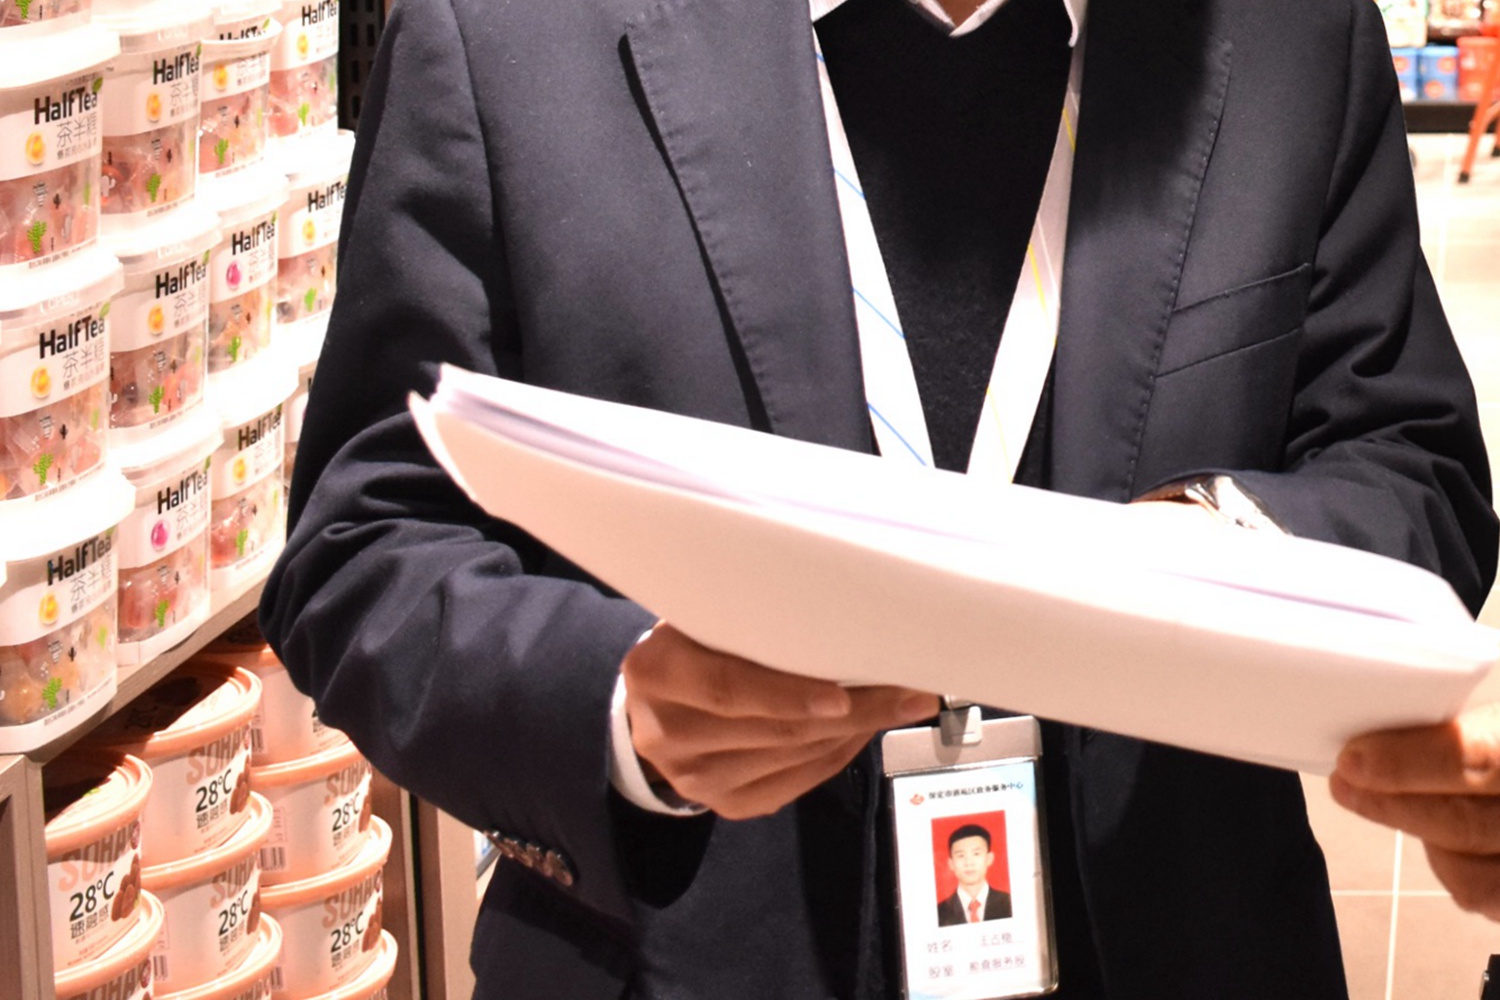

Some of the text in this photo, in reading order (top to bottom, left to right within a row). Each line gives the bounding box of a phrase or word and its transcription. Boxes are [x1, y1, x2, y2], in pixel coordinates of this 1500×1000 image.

[153, 51, 201, 85] HalfTea
[34, 86, 98, 125] HalfTea
[231, 221, 276, 256] HalfTea
[155, 260, 207, 299] HalfTea
[39, 315, 105, 360] HalfTea
[157, 471, 209, 515] HalfTea
[47, 533, 112, 586] HalfTea
[69, 870, 116, 923] 28°C
